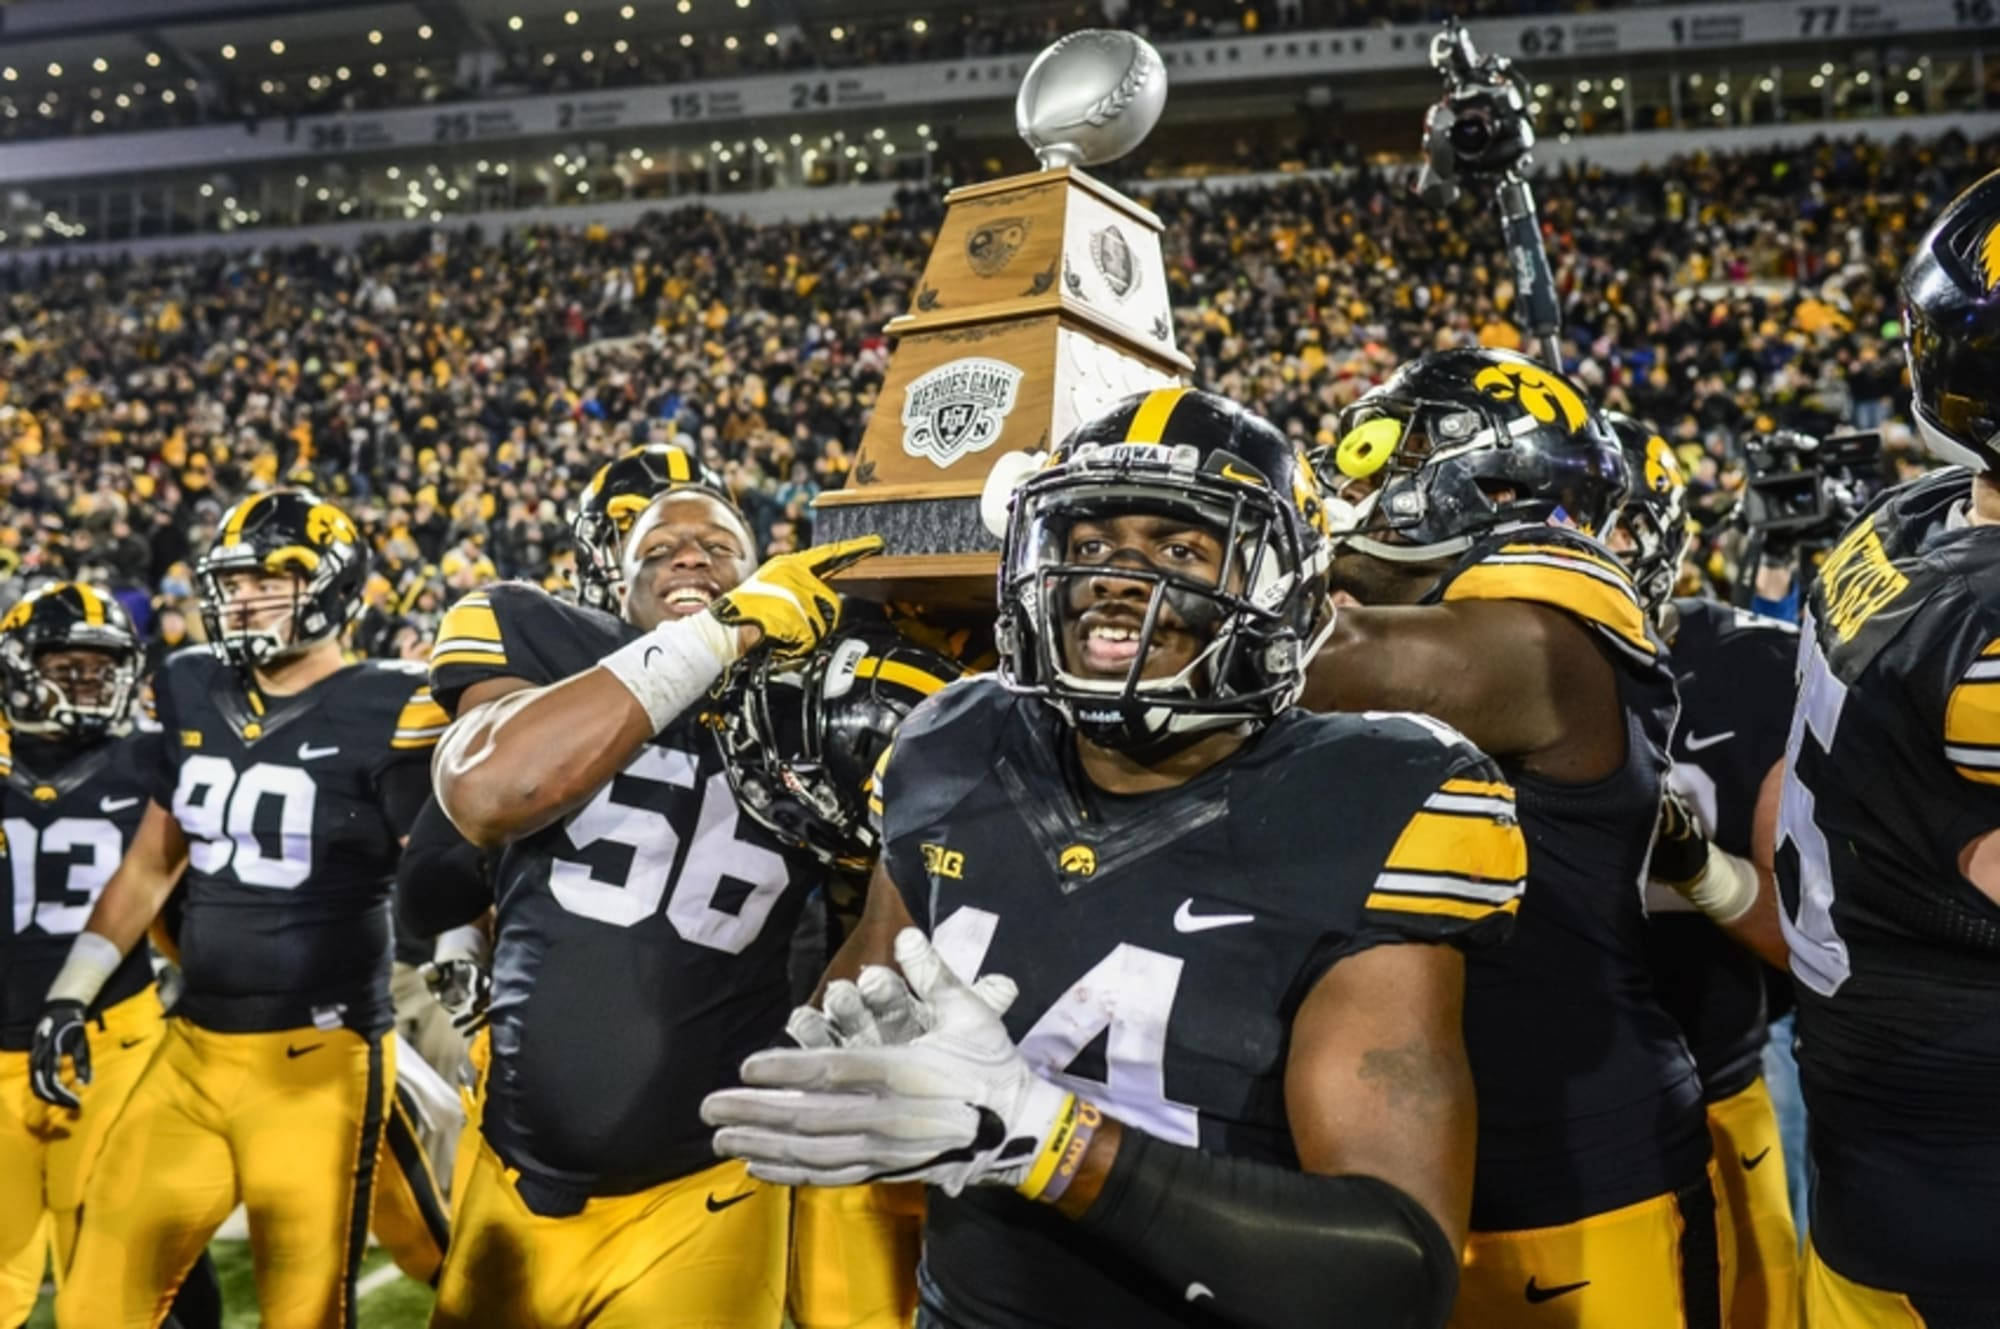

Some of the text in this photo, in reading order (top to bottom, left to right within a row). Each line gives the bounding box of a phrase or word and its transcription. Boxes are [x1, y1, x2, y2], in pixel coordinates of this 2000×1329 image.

[1669, 17, 1685, 44] 1
[1799, 6, 1841, 34] 77
[1519, 25, 1565, 56] 62
[670, 91, 702, 118] 15
[790, 82, 830, 110] 24
[434, 113, 470, 141] 25
[557, 103, 574, 129] 2
[970, 371, 1010, 408] GAME
[1112, 446, 1160, 461] IOWA
[172, 754, 317, 889] 90
[549, 743, 790, 955] 56
